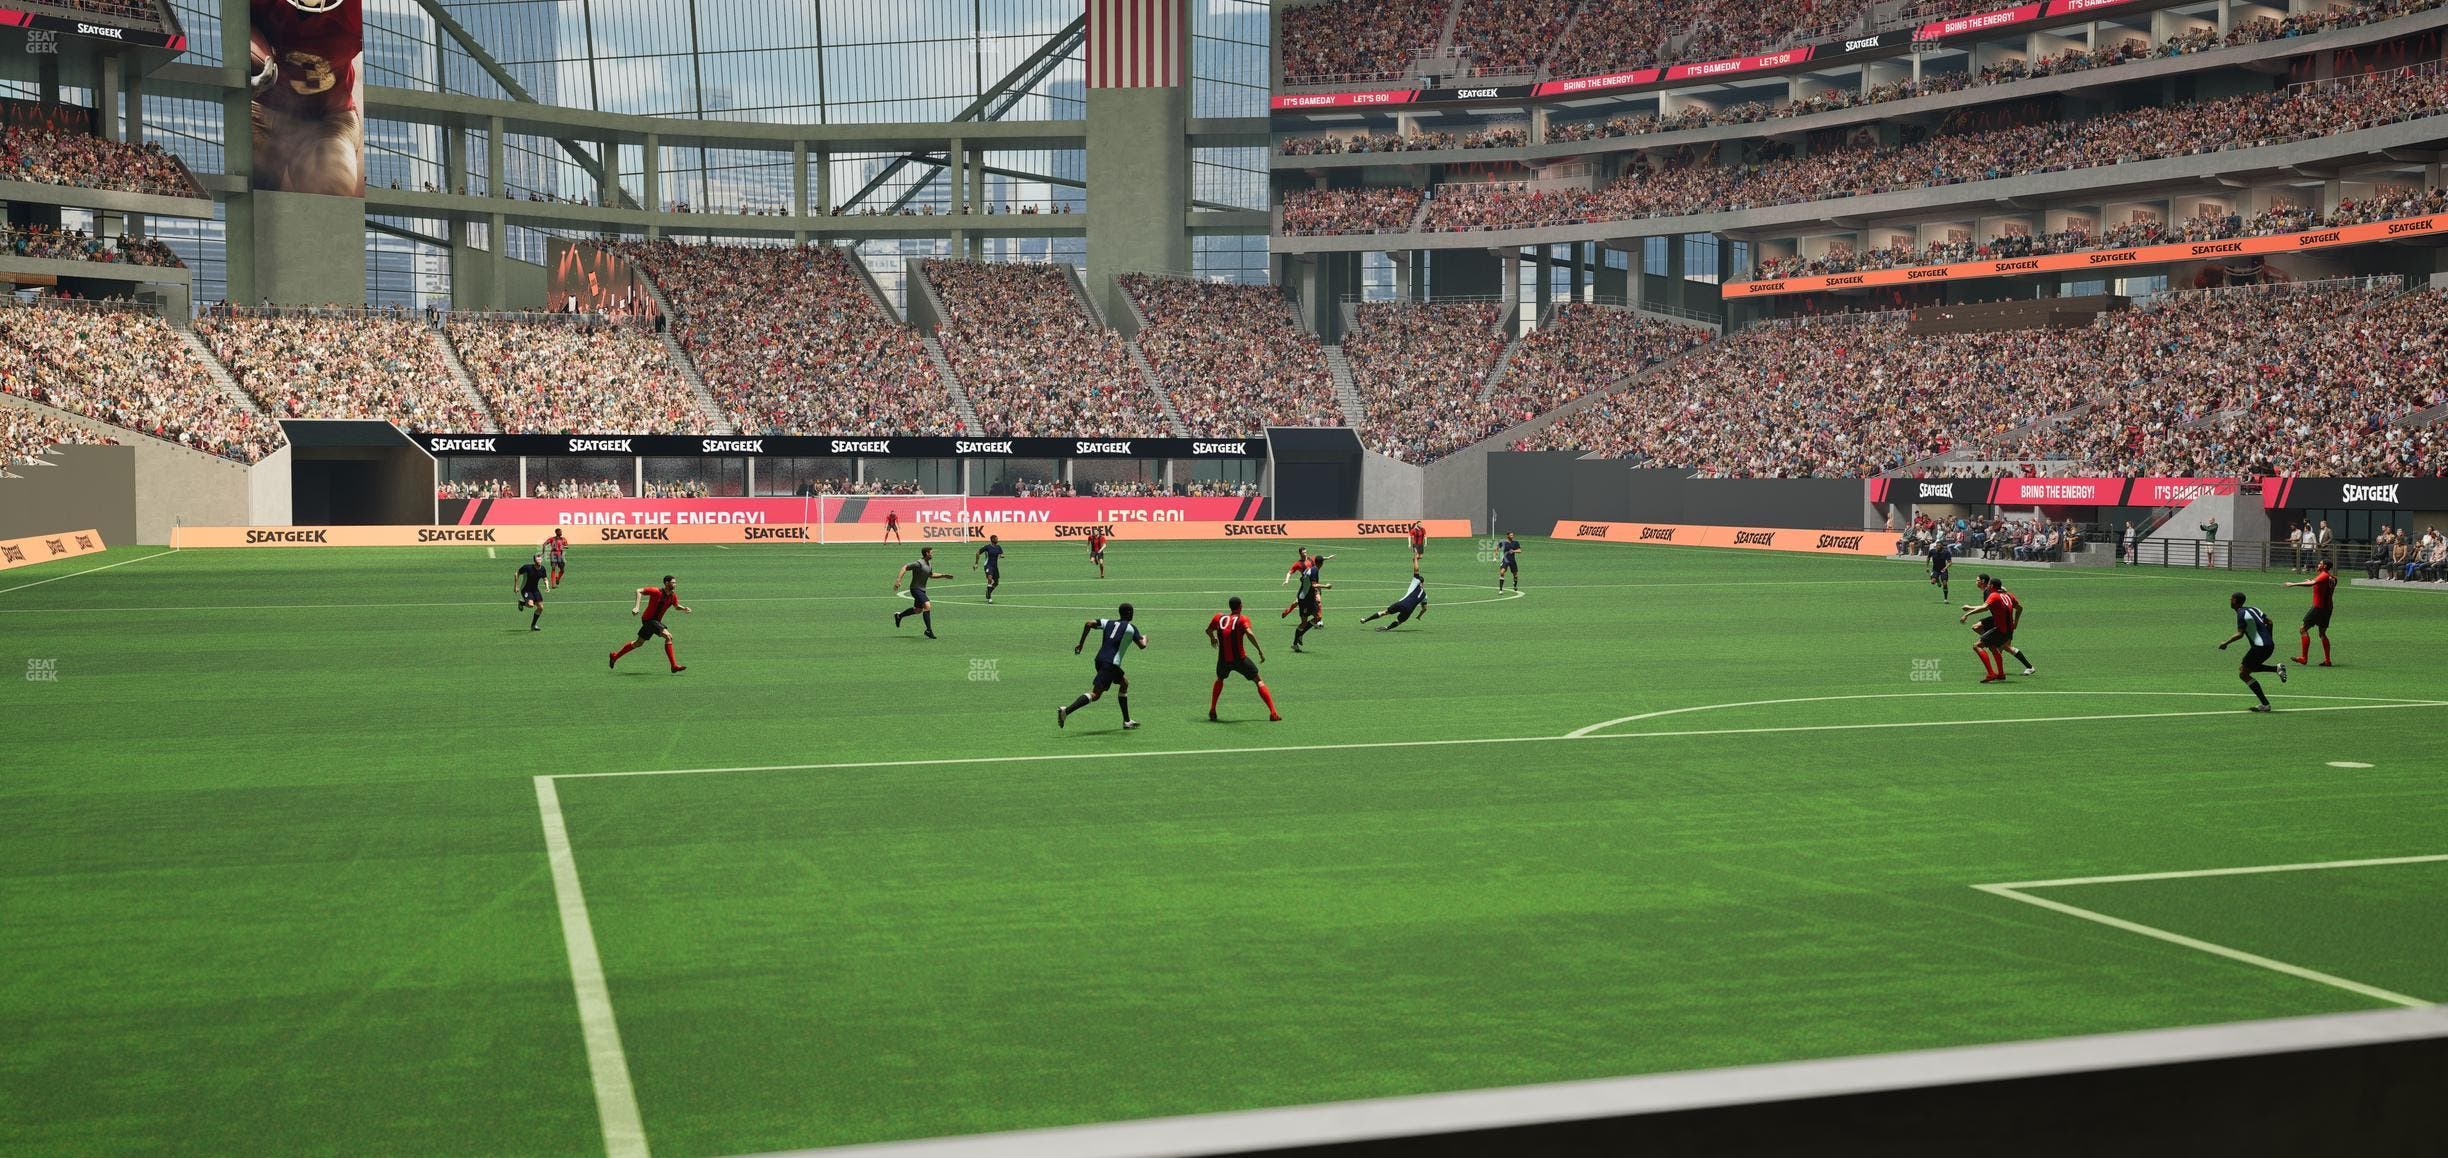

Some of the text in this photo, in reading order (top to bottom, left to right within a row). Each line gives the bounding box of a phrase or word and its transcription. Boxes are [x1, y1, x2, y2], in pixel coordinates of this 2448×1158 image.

[1945, 12, 2015, 33] BRING THE ENERGY!
[77, 23, 122, 39] SEATGEEK
[1845, 36, 1880, 52] SEATGEEK
[1687, 61, 1741, 76] IT'S GAMEDAY
[1759, 56, 1778, 67] LET'S
[1563, 75, 1634, 91] BRING THE ENERGY!
[1353, 94, 1374, 103] LET'S
[1457, 87, 1498, 99] SEATGEEK
[1299, 96, 1336, 105] GAMEDAY
[2388, 219, 2433, 234] SEATGEEK
[2299, 231, 2340, 245] SEATGEEK
[2191, 241, 2242, 255] SEATGEEK
[2089, 251, 2136, 264] SEATGEEK
[1995, 259, 2039, 272] SEATGEEK
[1907, 267, 1948, 280] SEATGEEK
[1826, 275, 1864, 287] SEATGEEK
[431, 438, 496, 453] SEATGEEK
[569, 438, 632, 453] SEATGEEK
[702, 439, 763, 453] SEATGEEK
[831, 440, 890, 454] SEATGEEK
[955, 440, 1013, 454] SEATGEEK
[1076, 441, 1131, 455] SEATGEEK
[1192, 442, 1246, 455] SEATGEEK
[1919, 483, 1953, 499] SEATGEEK
[2021, 485, 2095, 499] BRING THE ENERGY!
[2154, 485, 2171, 499] IT'S
[2342, 483, 2400, 504] SEATGEEK
[246, 529, 328, 543] SEATGEEK
[418, 528, 496, 543] SEATGEEK
[601, 527, 669, 541] SEATGEEK
[744, 526, 810, 540] SEATGEEK
[1224, 523, 1288, 536] SEATGEEK
[1577, 524, 1610, 538] SEATGEEK
[1640, 527, 1676, 541] SEATGEEK
[1734, 530, 1775, 546] SEATGEEK
[1816, 533, 1863, 551] SEATGEEK
[1218, 615, 1240, 630] 01
[1109, 621, 1121, 639] 1
